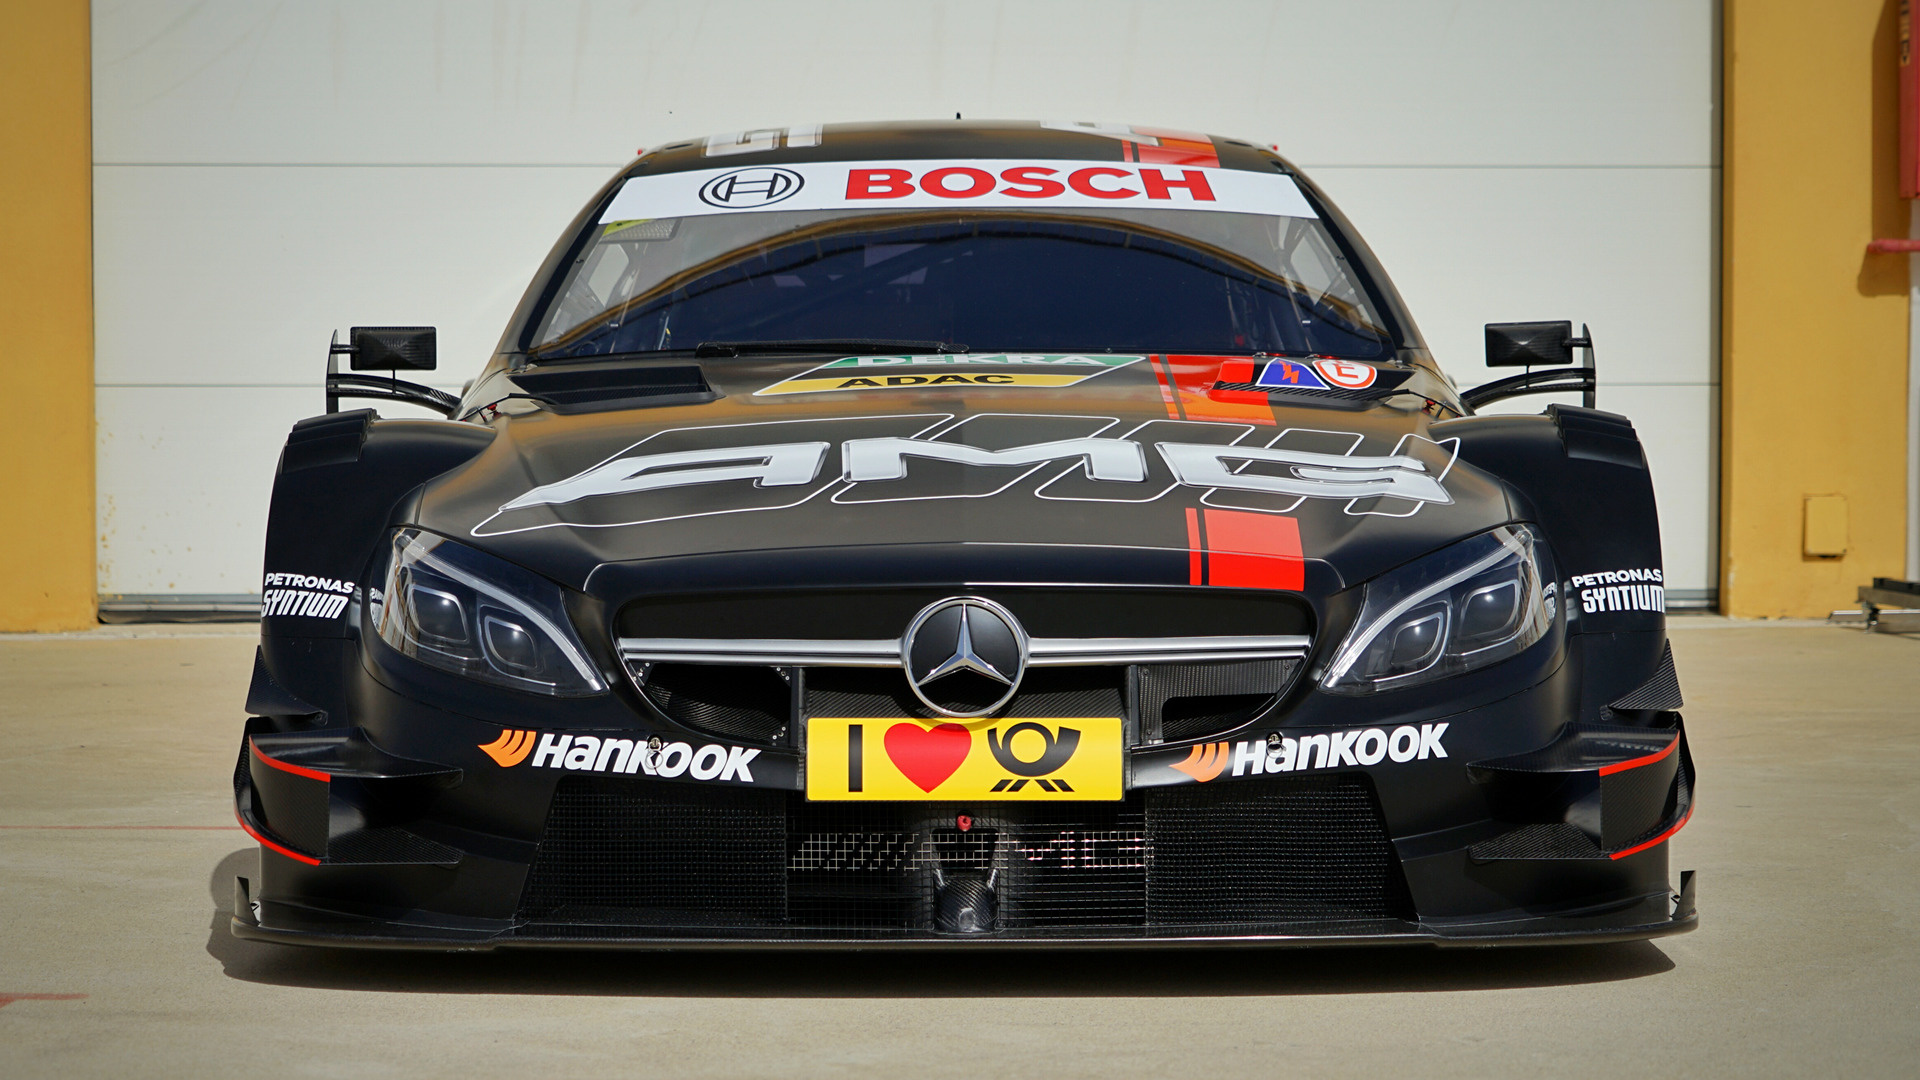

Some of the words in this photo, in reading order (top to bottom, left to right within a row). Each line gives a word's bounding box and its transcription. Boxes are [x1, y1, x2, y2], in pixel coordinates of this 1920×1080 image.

[845, 166, 1216, 201] BOSCH
[856, 354, 1105, 366] DEKRA
[836, 375, 1014, 388] ADAC
[498, 436, 1455, 505] AMG
[264, 572, 355, 594] PETRONAS
[1571, 568, 1663, 588] PETRONAS
[261, 588, 349, 619] SYNTIUM
[1581, 585, 1665, 614] SYNTIUM
[848, 724, 863, 792] I
